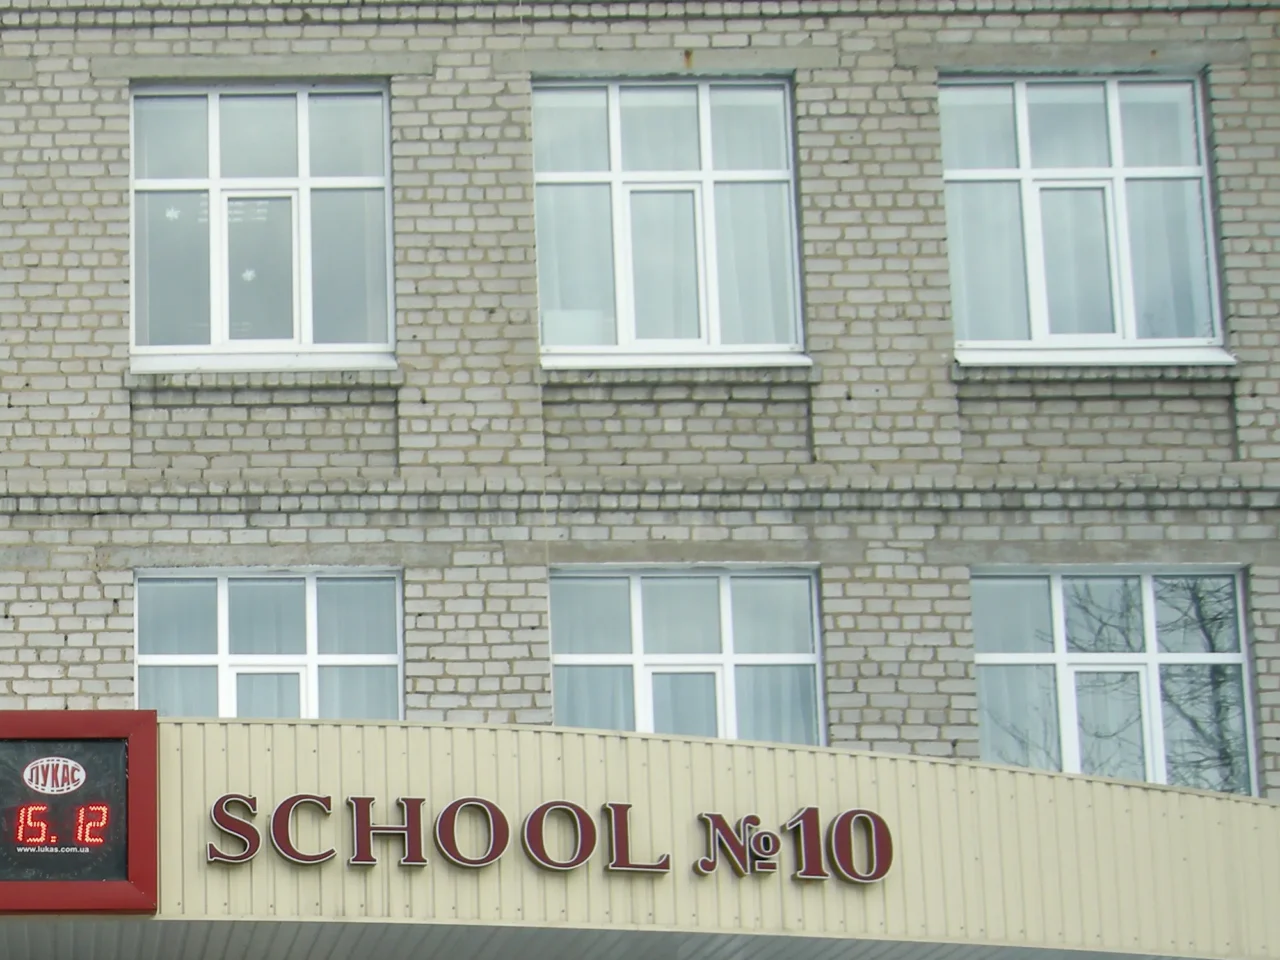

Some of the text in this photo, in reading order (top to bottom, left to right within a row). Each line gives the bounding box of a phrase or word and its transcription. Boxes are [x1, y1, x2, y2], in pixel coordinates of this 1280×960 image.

[27, 762, 81, 789] ЛУКАС
[207, 793, 672, 875] SCHOOL
[16, 845, 90, 854] www.lukas.com.ua
